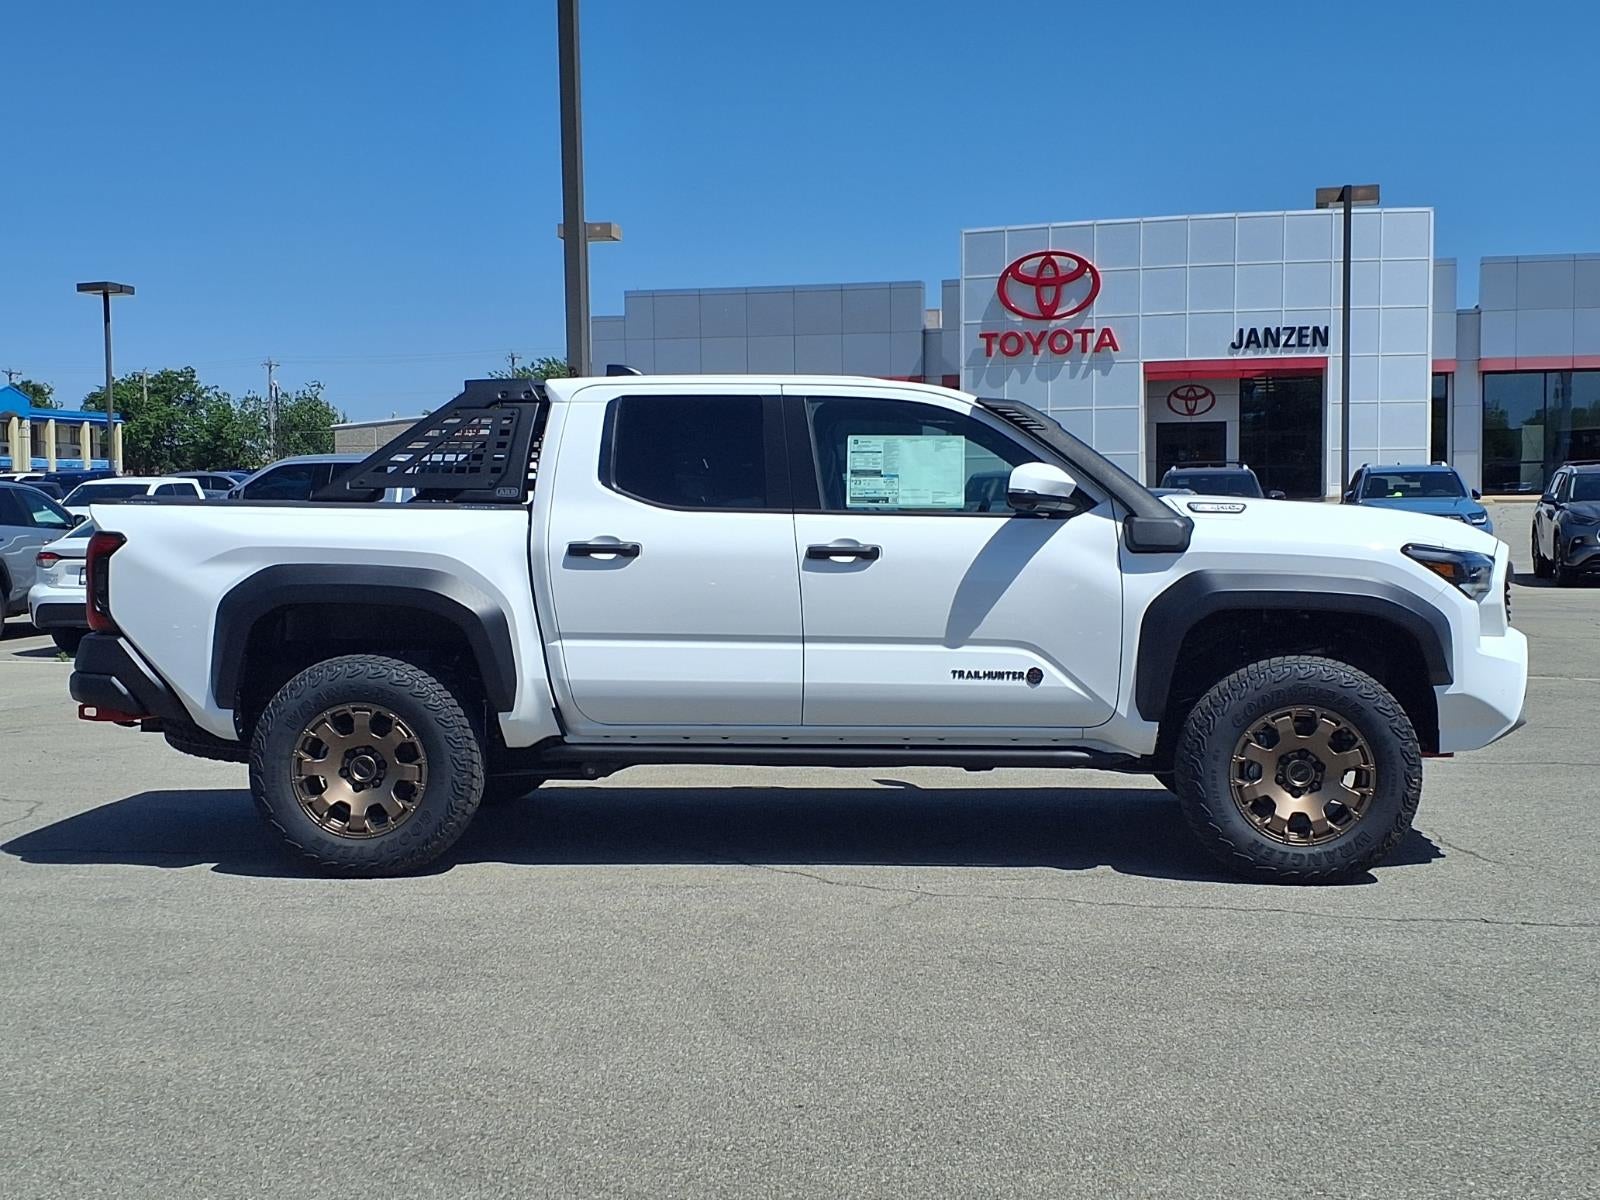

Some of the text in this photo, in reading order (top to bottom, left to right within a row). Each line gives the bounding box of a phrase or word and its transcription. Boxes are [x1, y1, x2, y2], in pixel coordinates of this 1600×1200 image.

[980, 328, 1120, 357] TOYOTA
[1231, 326, 1329, 350] JANZEN
[951, 669, 1025, 681] TRAILHUNTER
[1249, 831, 1372, 866] WRANGLER
